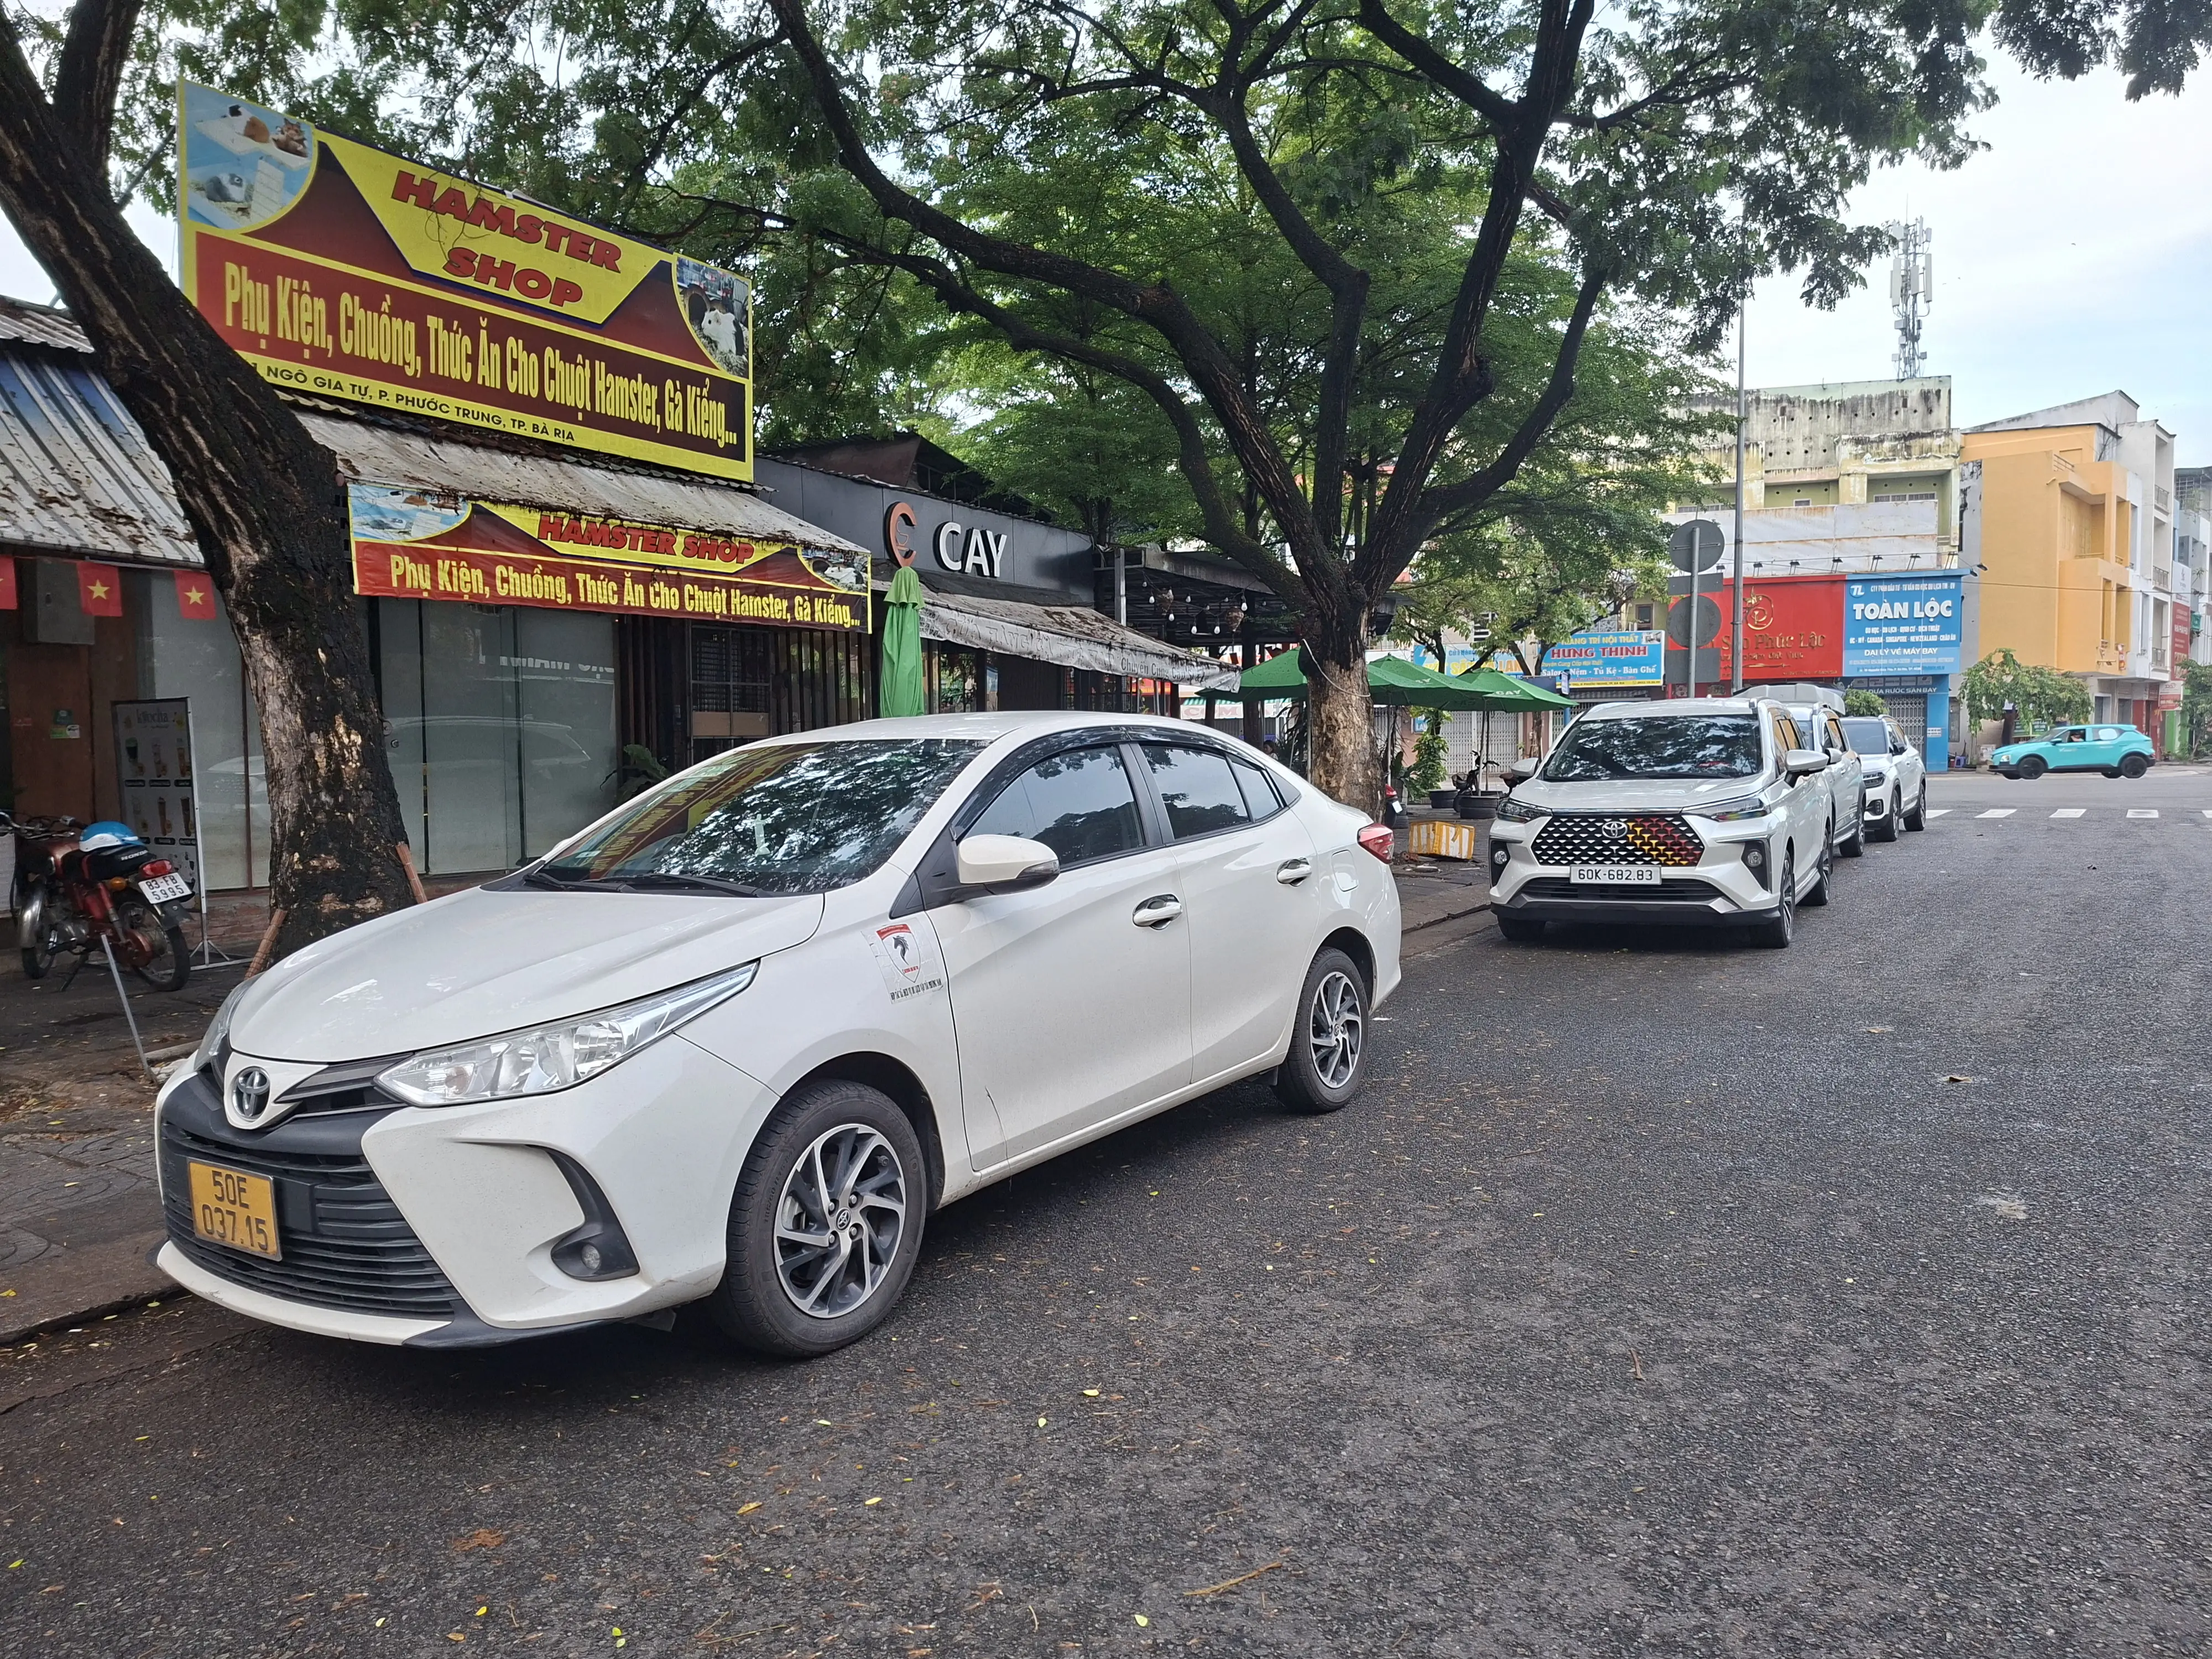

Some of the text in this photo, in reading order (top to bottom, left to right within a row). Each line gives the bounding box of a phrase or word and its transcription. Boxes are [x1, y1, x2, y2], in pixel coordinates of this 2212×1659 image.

[391, 169, 622, 274] HAMSTER
[442, 247, 583, 307] SHOP
[225, 262, 737, 448] Phụ Kiện, Chuồng, Thức Ăn Cho Chuột Hamster, Gà Kiểng...
[266, 366, 307, 384] NGÔ
[313, 375, 345, 392] GIA
[378, 390, 389, 401] P.
[395, 392, 450, 414] PHƯỚC
[455, 405, 506, 429] TRUNG,
[510, 418, 528, 431] TP.
[532, 421, 549, 436] BÀ
[554, 427, 575, 442] RỊA
[538, 515, 755, 564] HAMSTER SHOP
[936, 522, 1008, 577] CAY
[390, 555, 860, 627] Phụ Kiện, Chuồng, Thức Ăn Cho Chuột Hamster, Gà Kiểng...
[1853, 597, 1952, 622] TOÀN LỘC
[1152, 663, 1169, 680] Cung
[1551, 646, 1648, 659] HƯNG THỊNH
[121, 849, 149, 861] HONDA
[1578, 869, 1653, 881] 60K-682.83
[146, 874, 178, 890] 83-FB
[152, 884, 184, 900] 5995
[211, 1170, 249, 1209] 50E
[202, 1203, 268, 1251] 037.15
